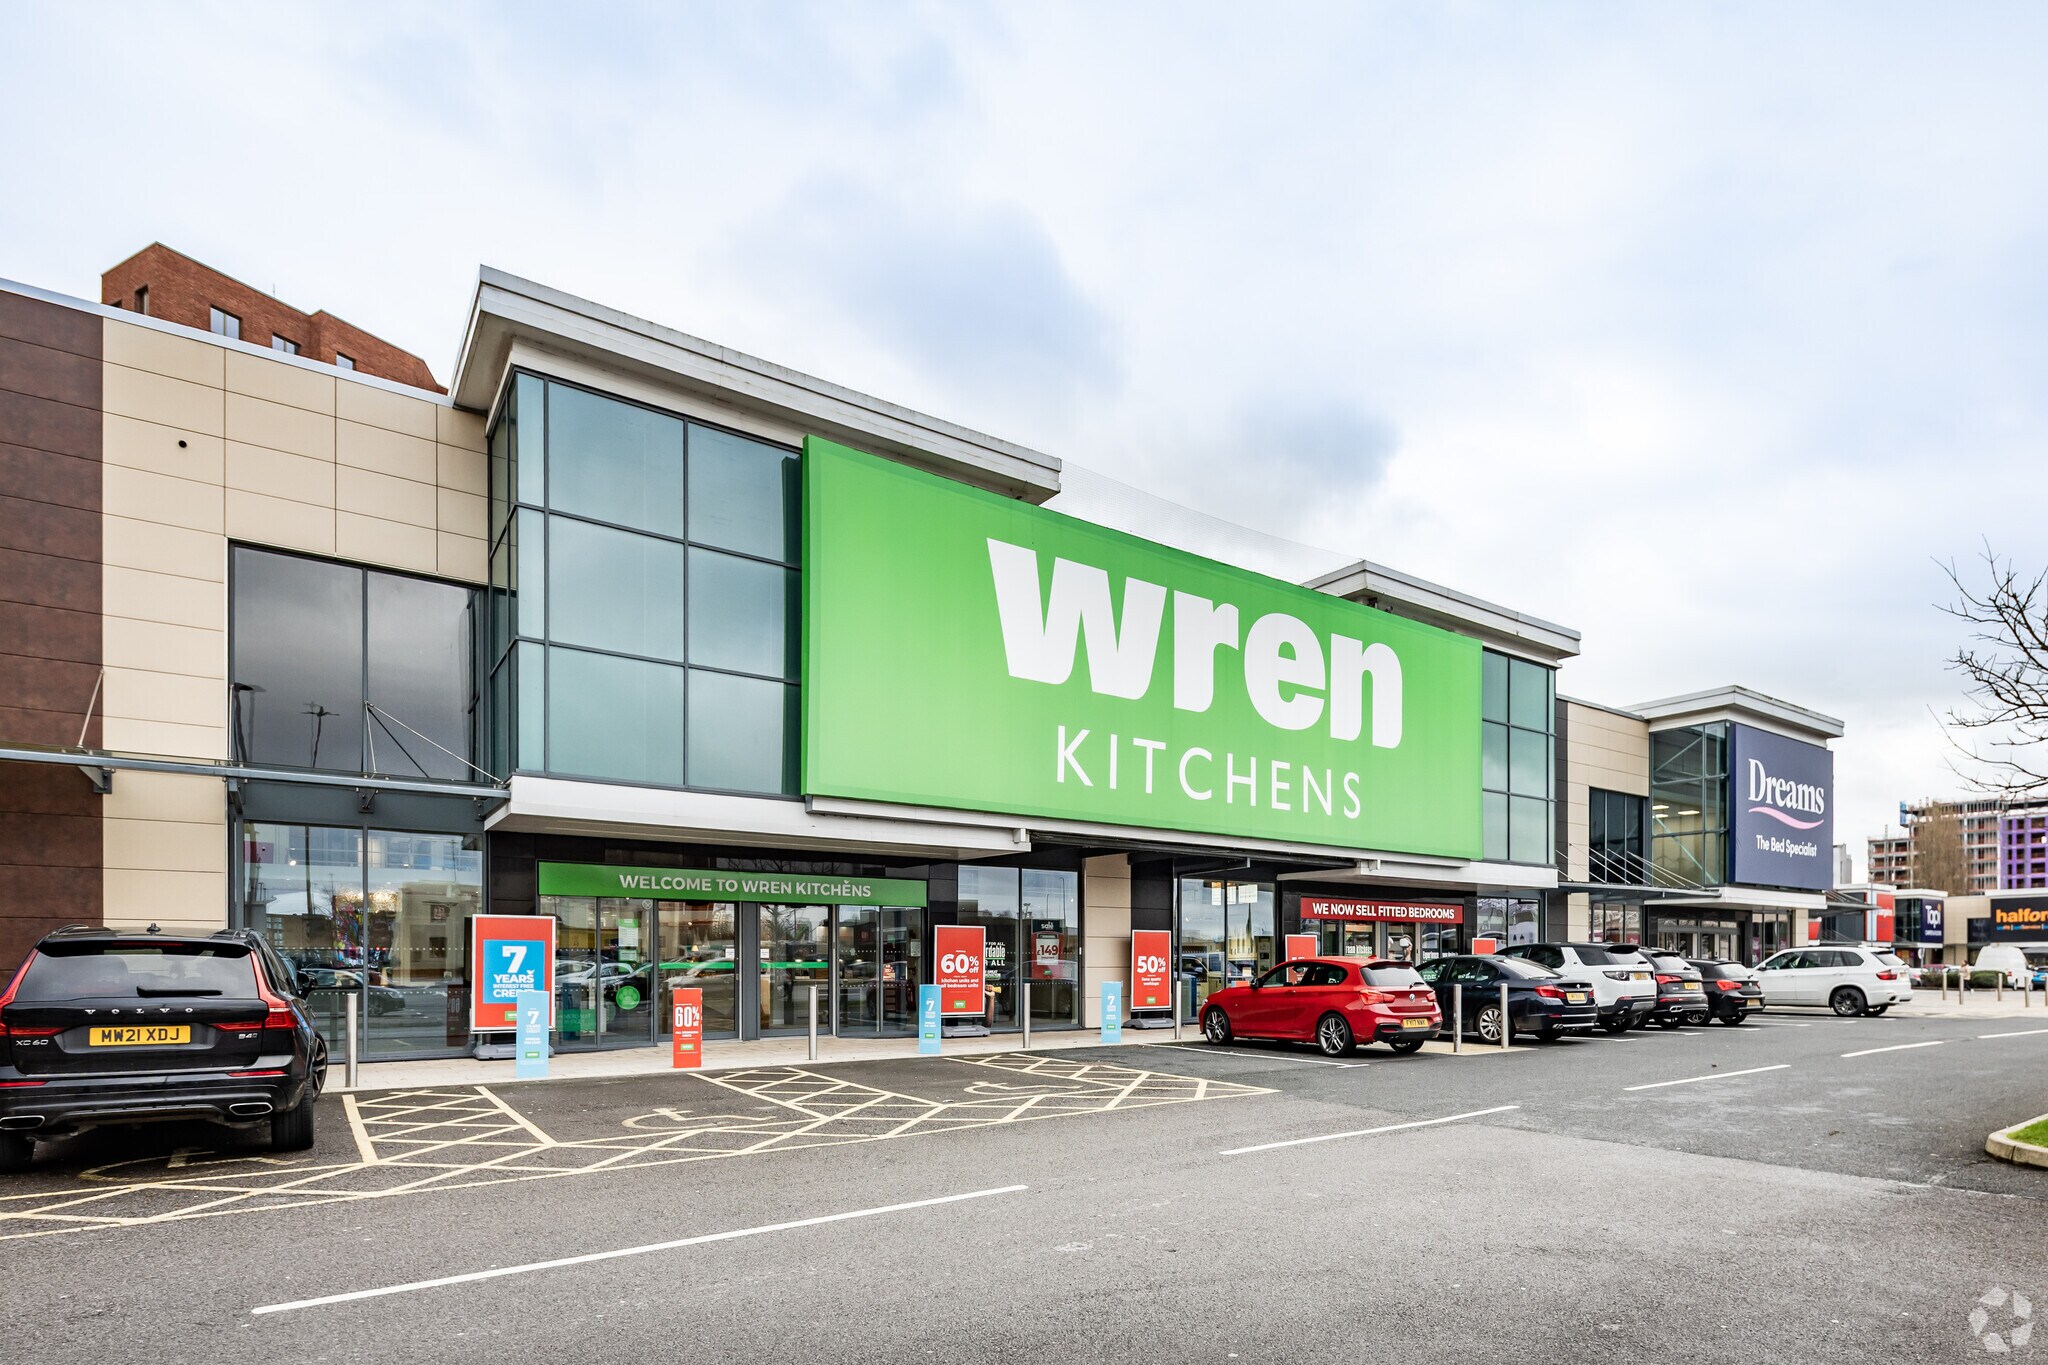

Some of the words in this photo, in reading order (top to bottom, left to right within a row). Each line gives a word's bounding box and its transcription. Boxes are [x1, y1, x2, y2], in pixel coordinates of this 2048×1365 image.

[987, 537, 1403, 749] wren
[1056, 725, 1361, 819] KITCHENS
[1748, 758, 1825, 814] Dreams
[1756, 834, 1769, 851] The
[1771, 837, 1785, 853] Bed
[1786, 839, 1817, 858] Specialist
[619, 874, 712, 892] WELCOME
[716, 879, 738, 892] TO
[742, 880, 792, 895] WREN
[796, 880, 872, 897] KITCHENS
[1312, 903, 1329, 915] WE
[1331, 903, 1354, 916] NOW
[1355, 905, 1377, 917] SELL
[1378, 905, 1408, 918] FITTED
[1409, 907, 1455, 919] BEDROOMS
[985, 945, 1006, 957] rdable
[1037, 945, 1058, 955] £149
[502, 946, 527, 973] 7
[941, 954, 979, 974] 60%
[1136, 955, 1166, 973] 50%
[493, 973, 534, 984] YEARS
[493, 989, 534, 998] CRE
[1107, 996, 1115, 1005] 7
[926, 1000, 935, 1011] 7
[528, 1011, 539, 1024] 7
[675, 1006, 700, 1027] 60%
[101, 1028, 141, 1043] MW21
[146, 1027, 179, 1041] XDJ
